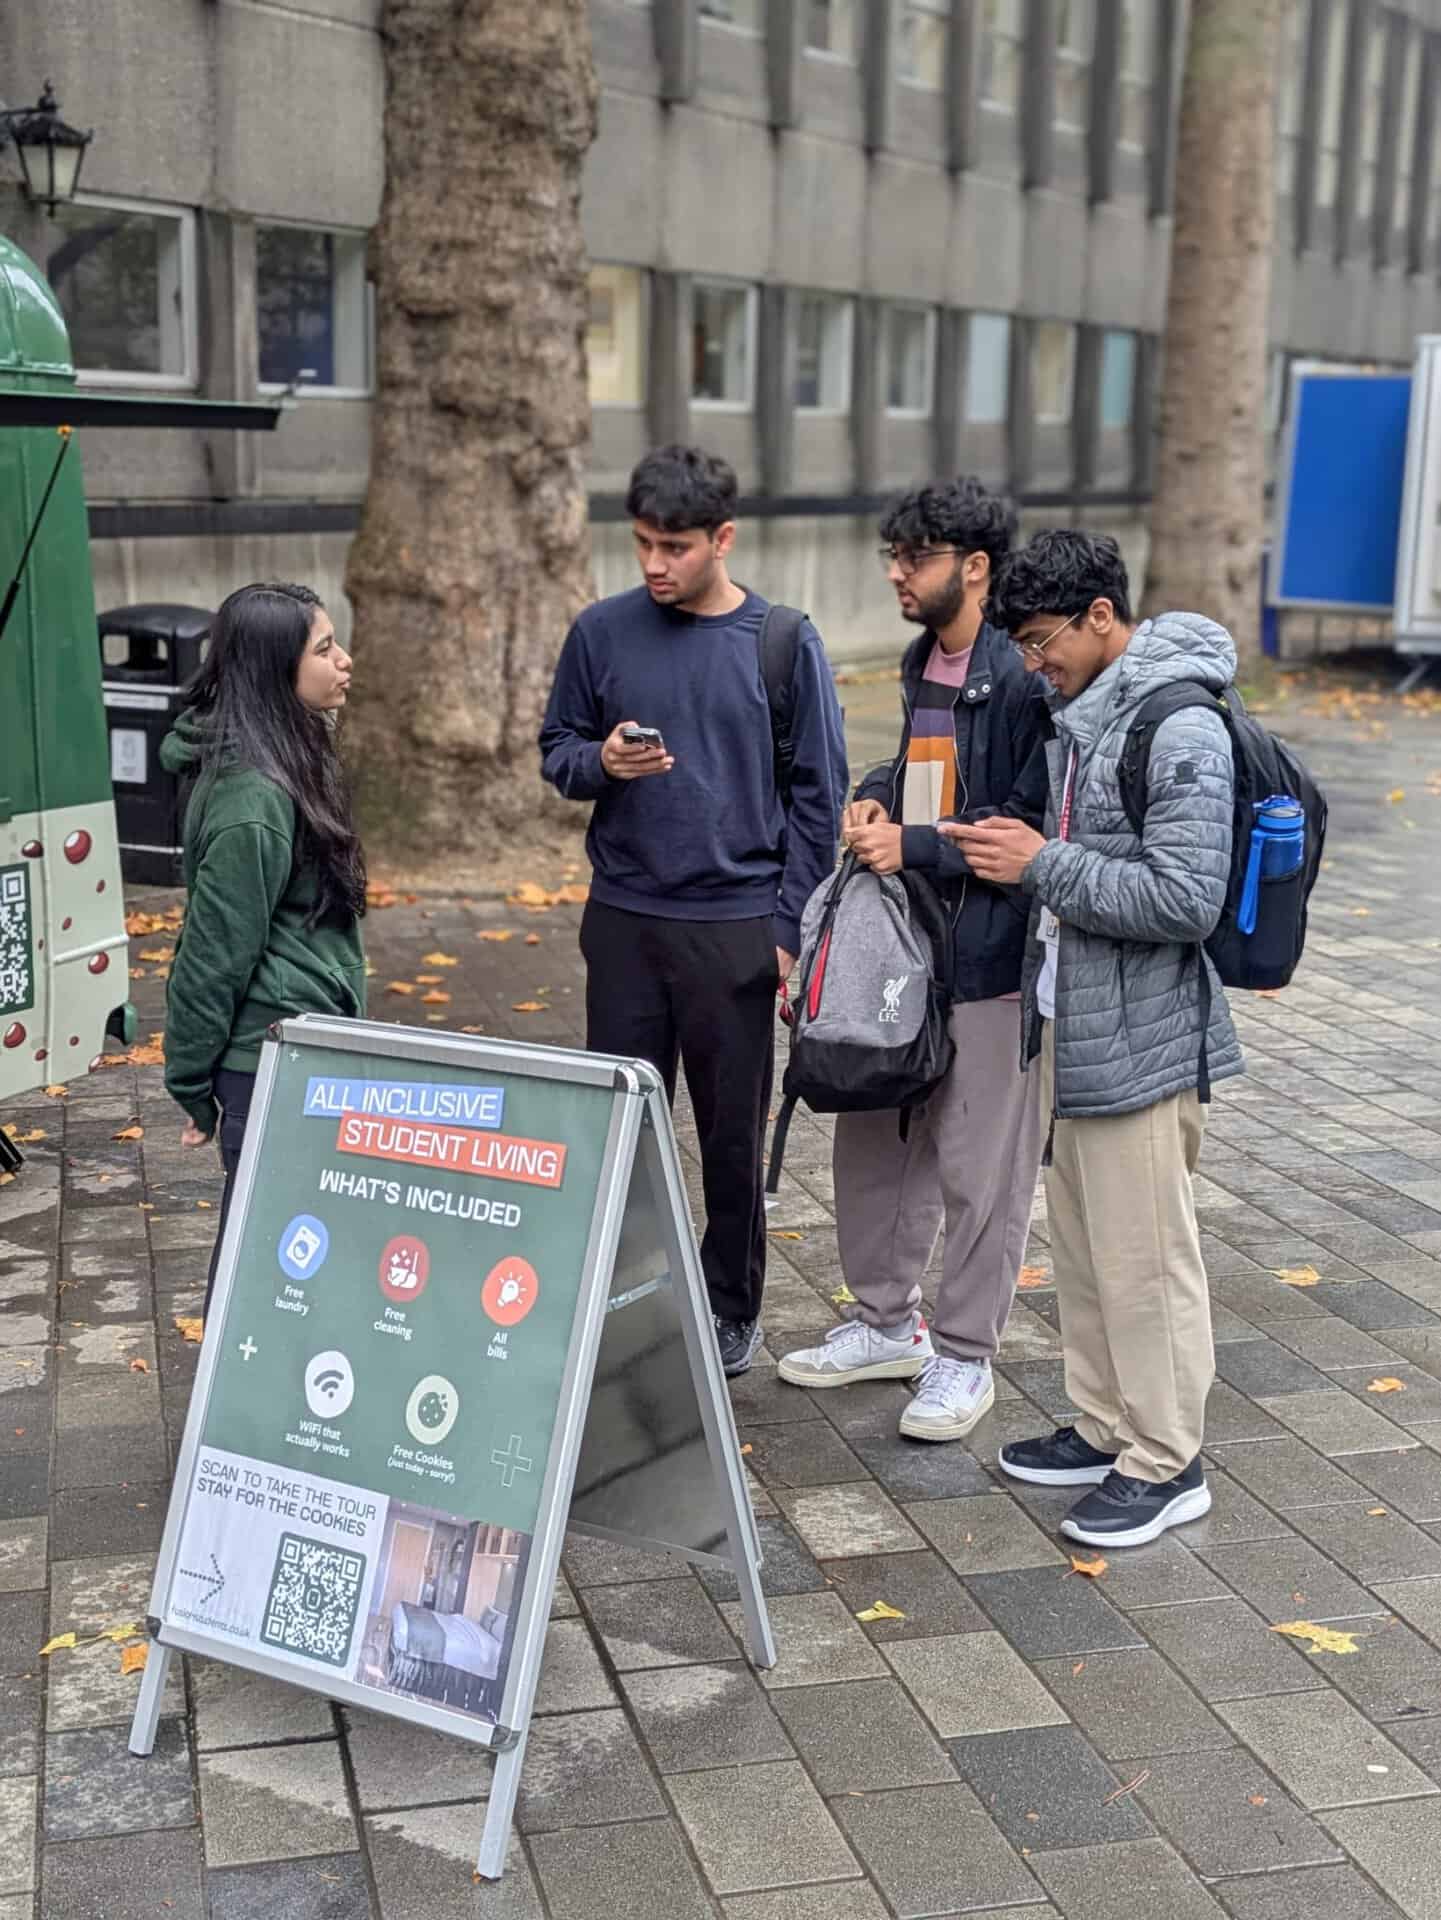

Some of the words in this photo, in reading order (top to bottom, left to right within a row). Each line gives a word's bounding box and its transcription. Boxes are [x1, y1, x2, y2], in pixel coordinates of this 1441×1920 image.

[879, 1011, 900, 1023] LFC
[309, 1084, 353, 1111] ALL
[362, 1088, 499, 1121] INCLUSIVE
[344, 1119, 466, 1163] STUDENT
[471, 1139, 559, 1178] LIVING
[319, 1169, 401, 1205] WHAT'S
[406, 1186, 521, 1228] INCLUDED
[284, 1284, 304, 1299] Free
[274, 1296, 309, 1316] laundry
[384, 1307, 406, 1322] Free
[373, 1320, 412, 1341] cleaning
[492, 1331, 508, 1344] All
[487, 1344, 508, 1360] bills
[322, 1426, 341, 1440] that
[285, 1433, 321, 1452] actually
[322, 1442, 350, 1457] works
[393, 1444, 414, 1459] Free
[415, 1450, 454, 1470] Cookies
[200, 1459, 239, 1484] SCAN
[244, 1470, 262, 1488] TO
[266, 1476, 300, 1499] TAKE
[305, 1487, 333, 1508] THE
[337, 1495, 377, 1520] TOUR
[197, 1477, 233, 1497] STAY
[236, 1488, 265, 1508] FOR
[268, 1497, 297, 1518] THE
[300, 1506, 367, 1538] COOKIES
